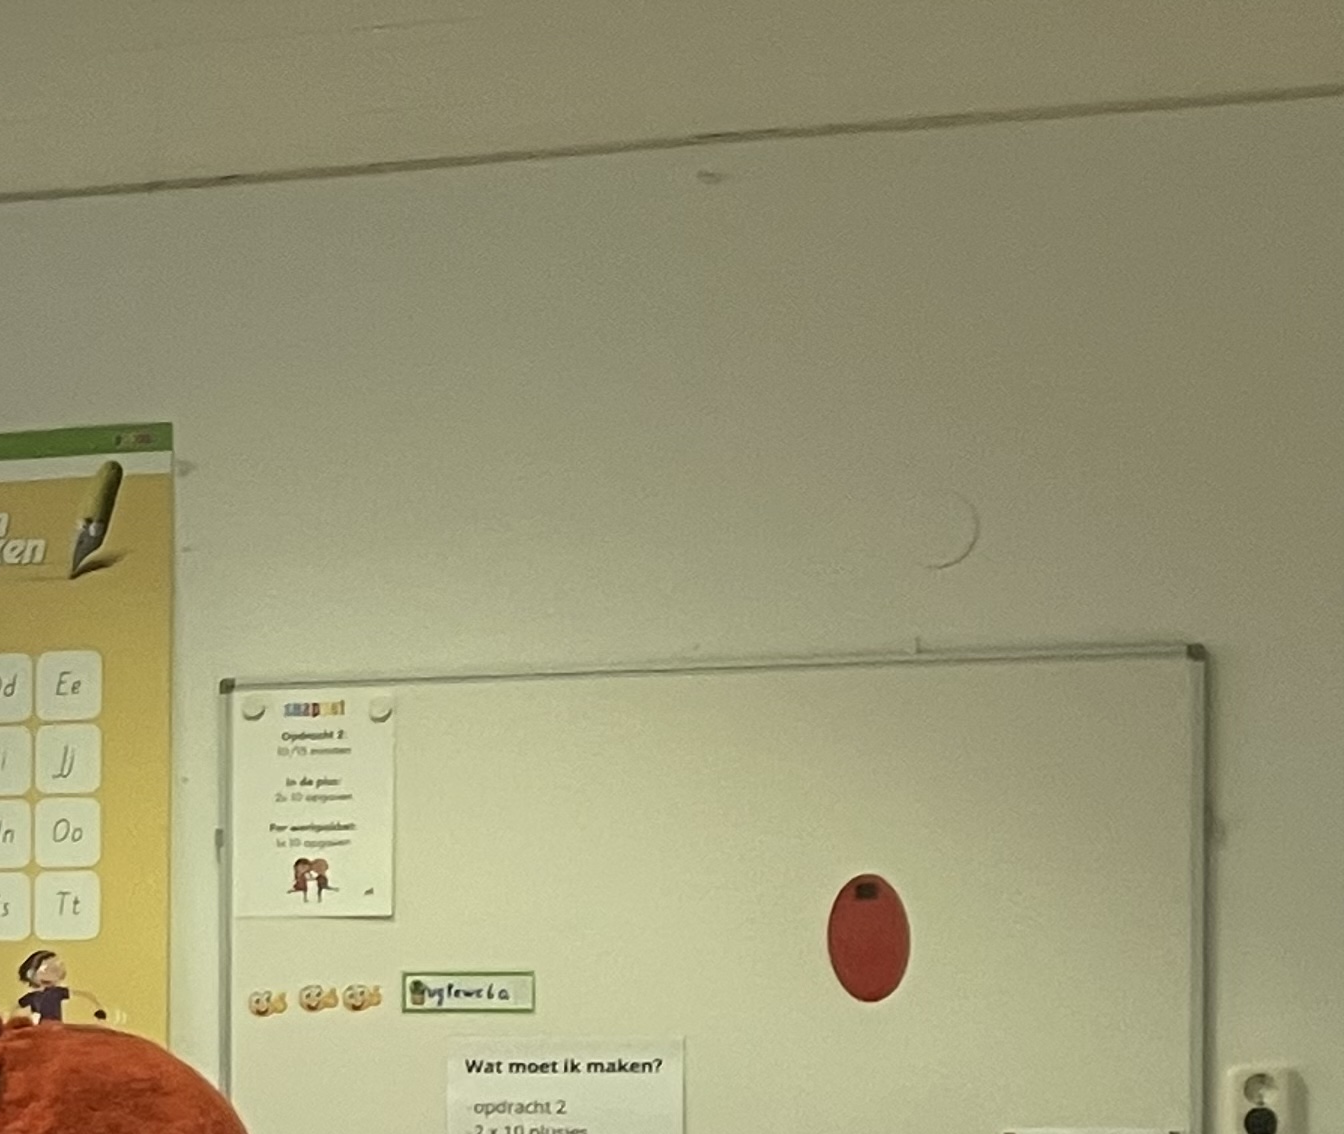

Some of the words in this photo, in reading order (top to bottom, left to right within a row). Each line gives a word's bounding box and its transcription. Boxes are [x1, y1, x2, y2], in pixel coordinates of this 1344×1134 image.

[56, 671, 82, 696] Ee
[52, 818, 83, 843] Oo
[55, 891, 81, 915] Tt
[465, 1059, 502, 1074] Wat
[509, 1060, 558, 1074] moet
[586, 1058, 662, 1074] maken?
[474, 1100, 551, 1119] opdracht
[556, 1101, 566, 1115] 2
